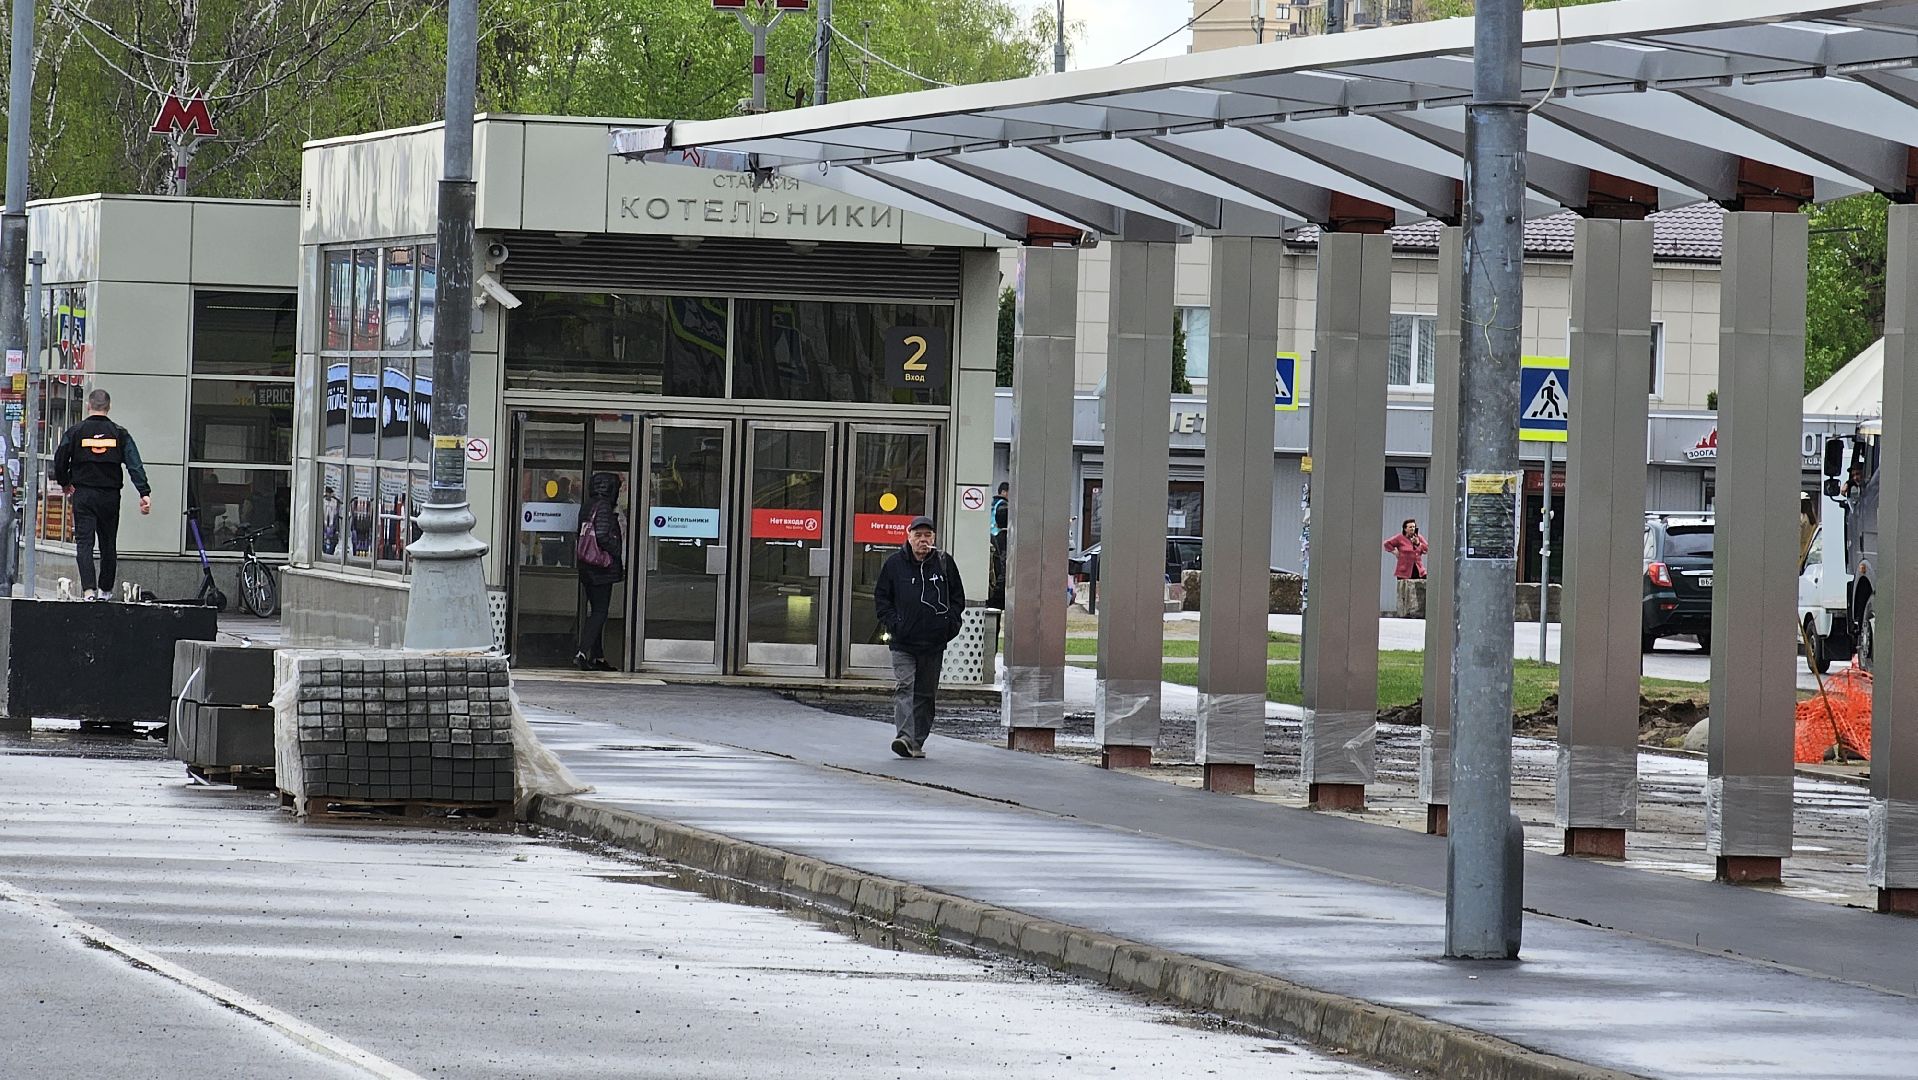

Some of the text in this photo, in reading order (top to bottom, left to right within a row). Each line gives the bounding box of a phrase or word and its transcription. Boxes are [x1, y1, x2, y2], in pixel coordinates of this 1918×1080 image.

[621, 197, 891, 228] КОТЕЛЬНИКИ
[904, 336, 927, 370] 2
[905, 374, 925, 382] Вход
[1689, 449, 1715, 458] ЗООГА
